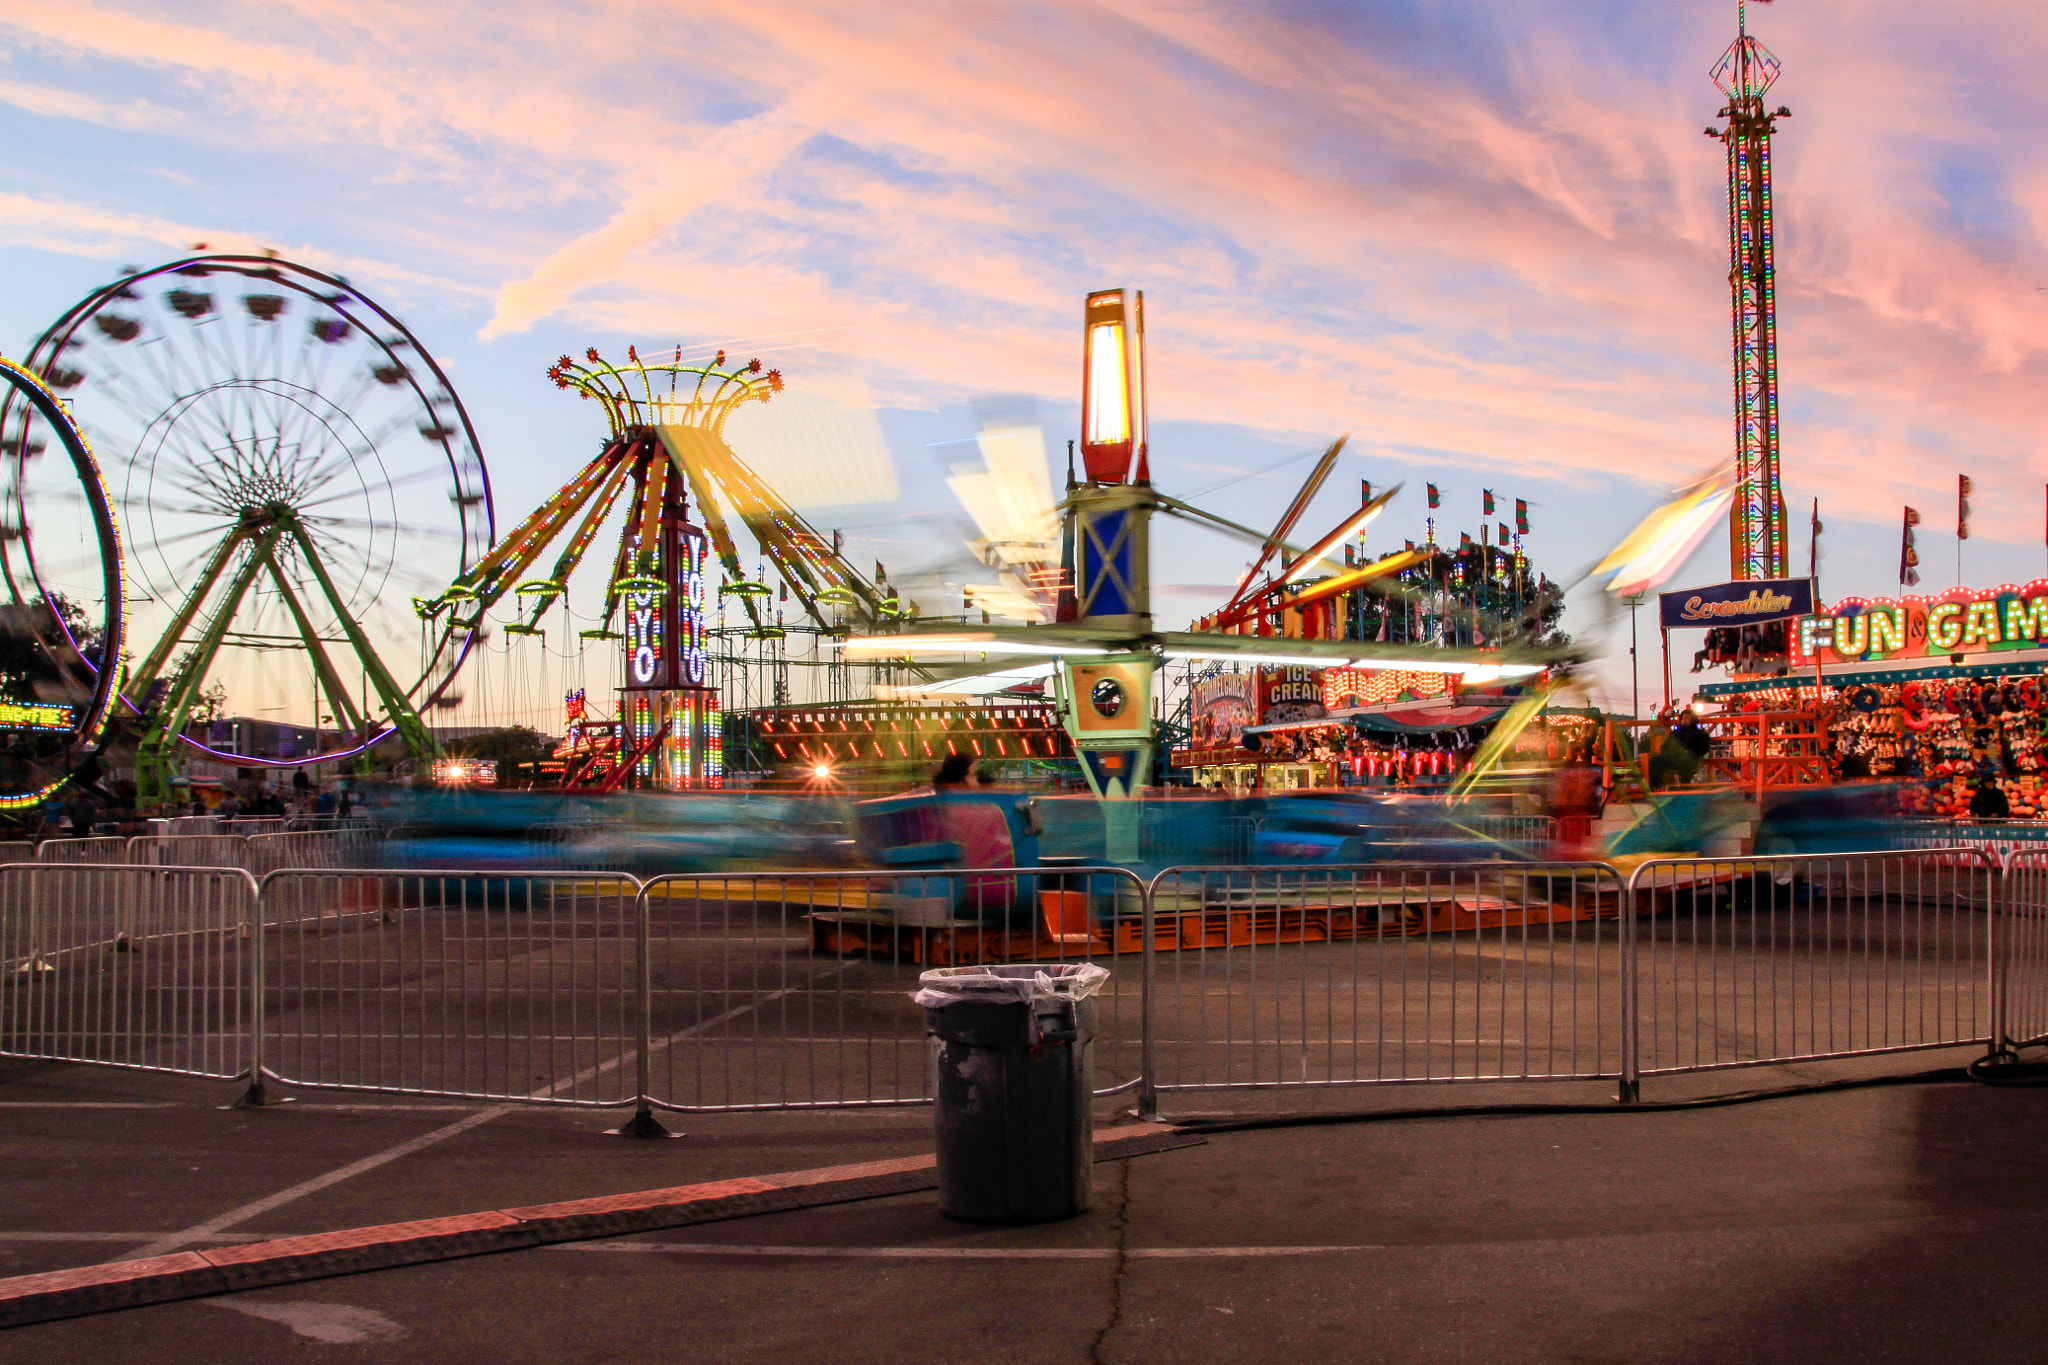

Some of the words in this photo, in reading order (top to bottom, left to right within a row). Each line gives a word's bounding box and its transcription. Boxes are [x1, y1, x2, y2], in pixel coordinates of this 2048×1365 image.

[688, 535, 703, 682] YOYO
[1681, 589, 1792, 620] Scrambler
[1802, 607, 1908, 657] FUN
[1911, 616, 1923, 639] &
[1928, 596, 2048, 649] GAM
[1286, 665, 1312, 682] ICE
